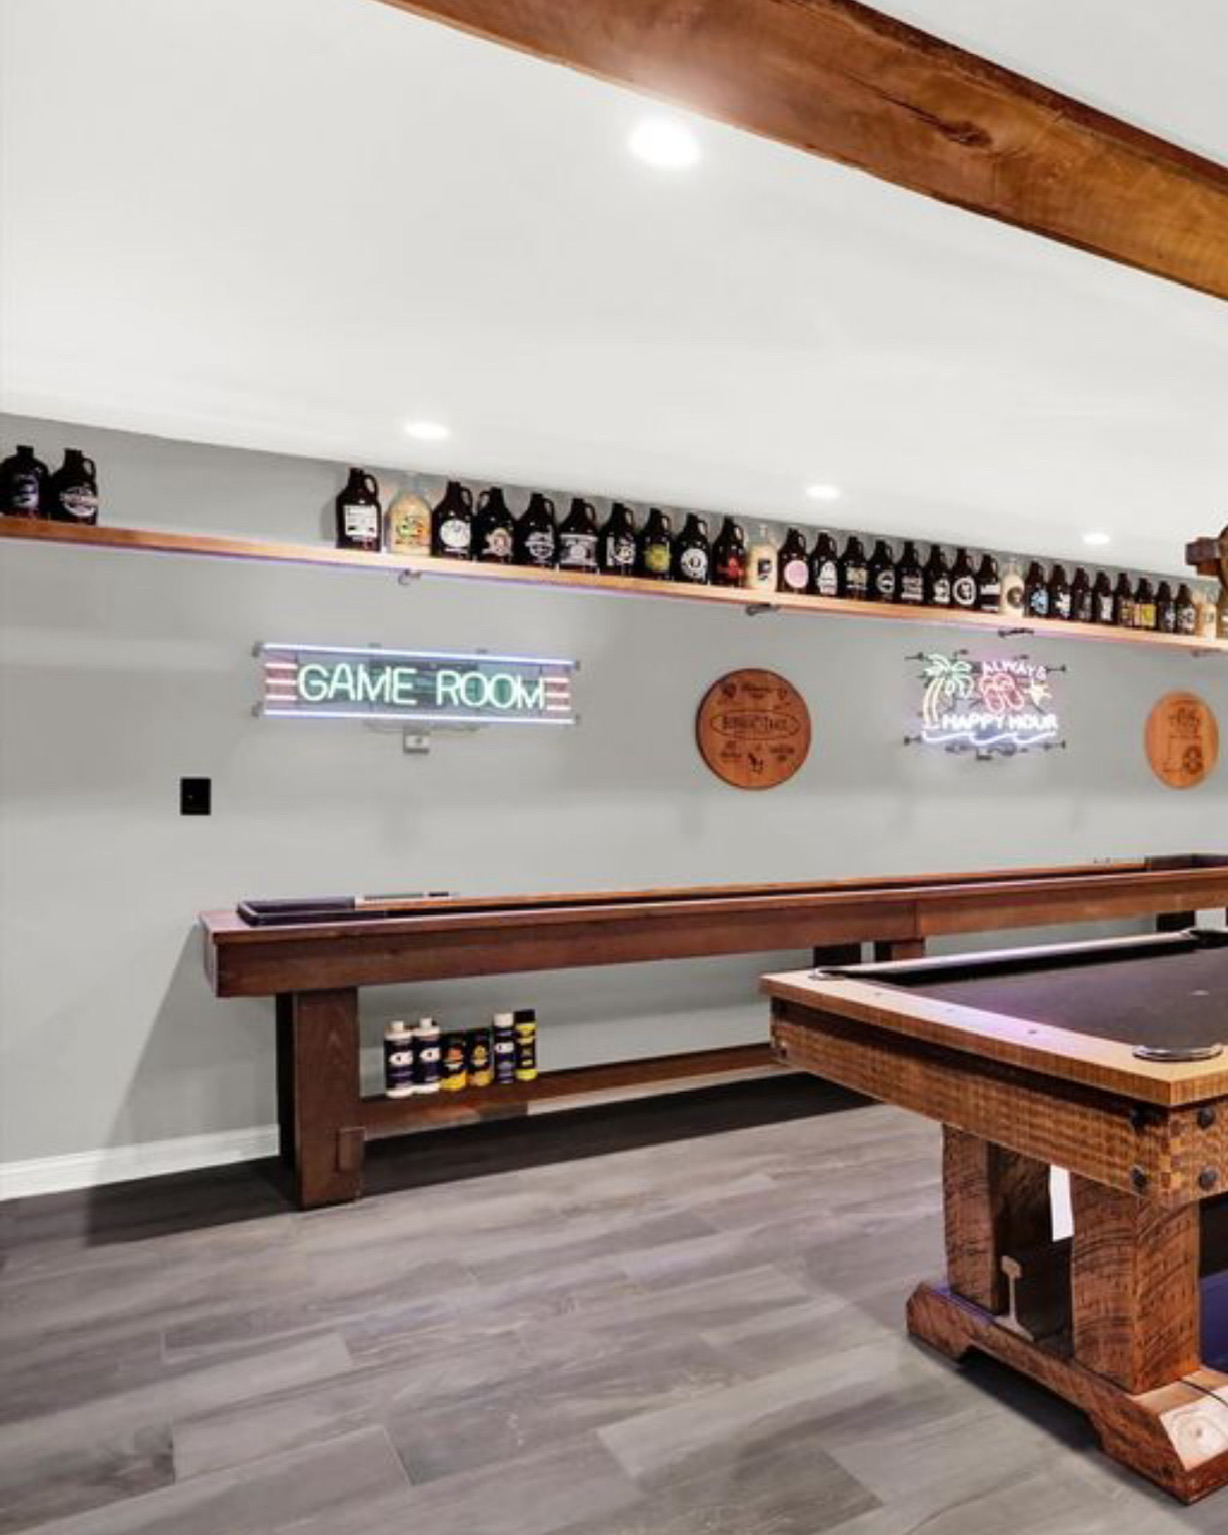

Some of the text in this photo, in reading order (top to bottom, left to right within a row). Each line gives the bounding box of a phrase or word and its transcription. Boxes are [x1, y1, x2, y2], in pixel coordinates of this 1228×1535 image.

[982, 660, 1048, 681] ALWAYS
[298, 662, 547, 710] GAME ROOM
[943, 712, 1060, 733] HAPPY HOUR
